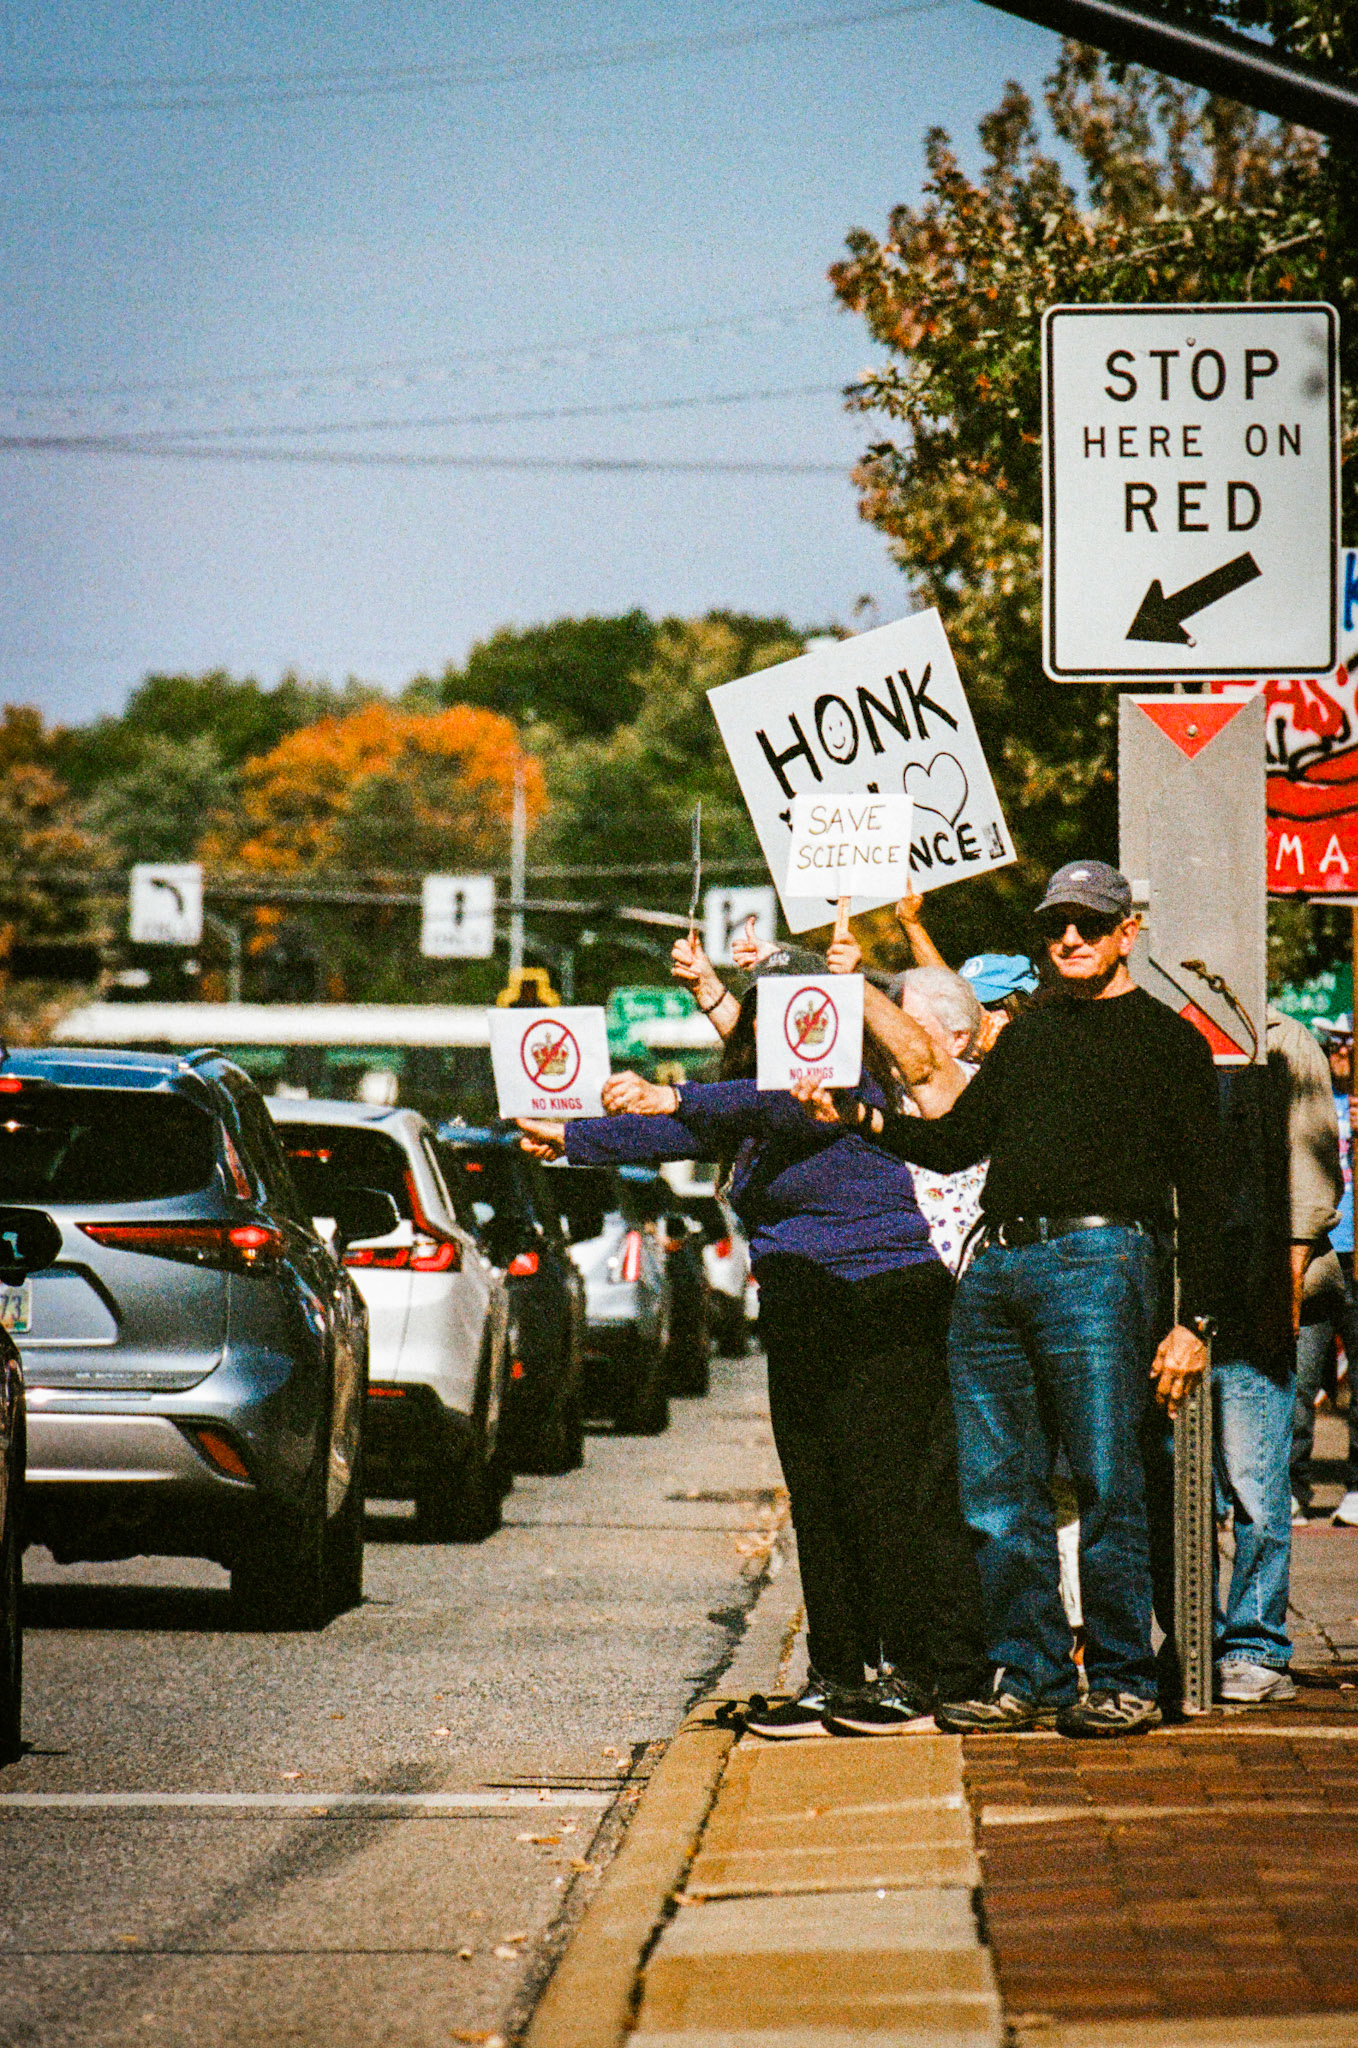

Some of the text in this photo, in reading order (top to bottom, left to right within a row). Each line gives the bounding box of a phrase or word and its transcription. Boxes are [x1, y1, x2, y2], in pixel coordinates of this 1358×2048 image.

[1104, 348, 1279, 401] STOP
[1083, 424, 1301, 458] HERE ON
[1124, 481, 1262, 533] RED
[755, 662, 959, 799] HONK
[809, 805, 886, 835] SAVE
[797, 845, 901, 870] SCIENCE
[789, 1067, 803, 1080] NO
[531, 1097, 583, 1110] NO KINGS
